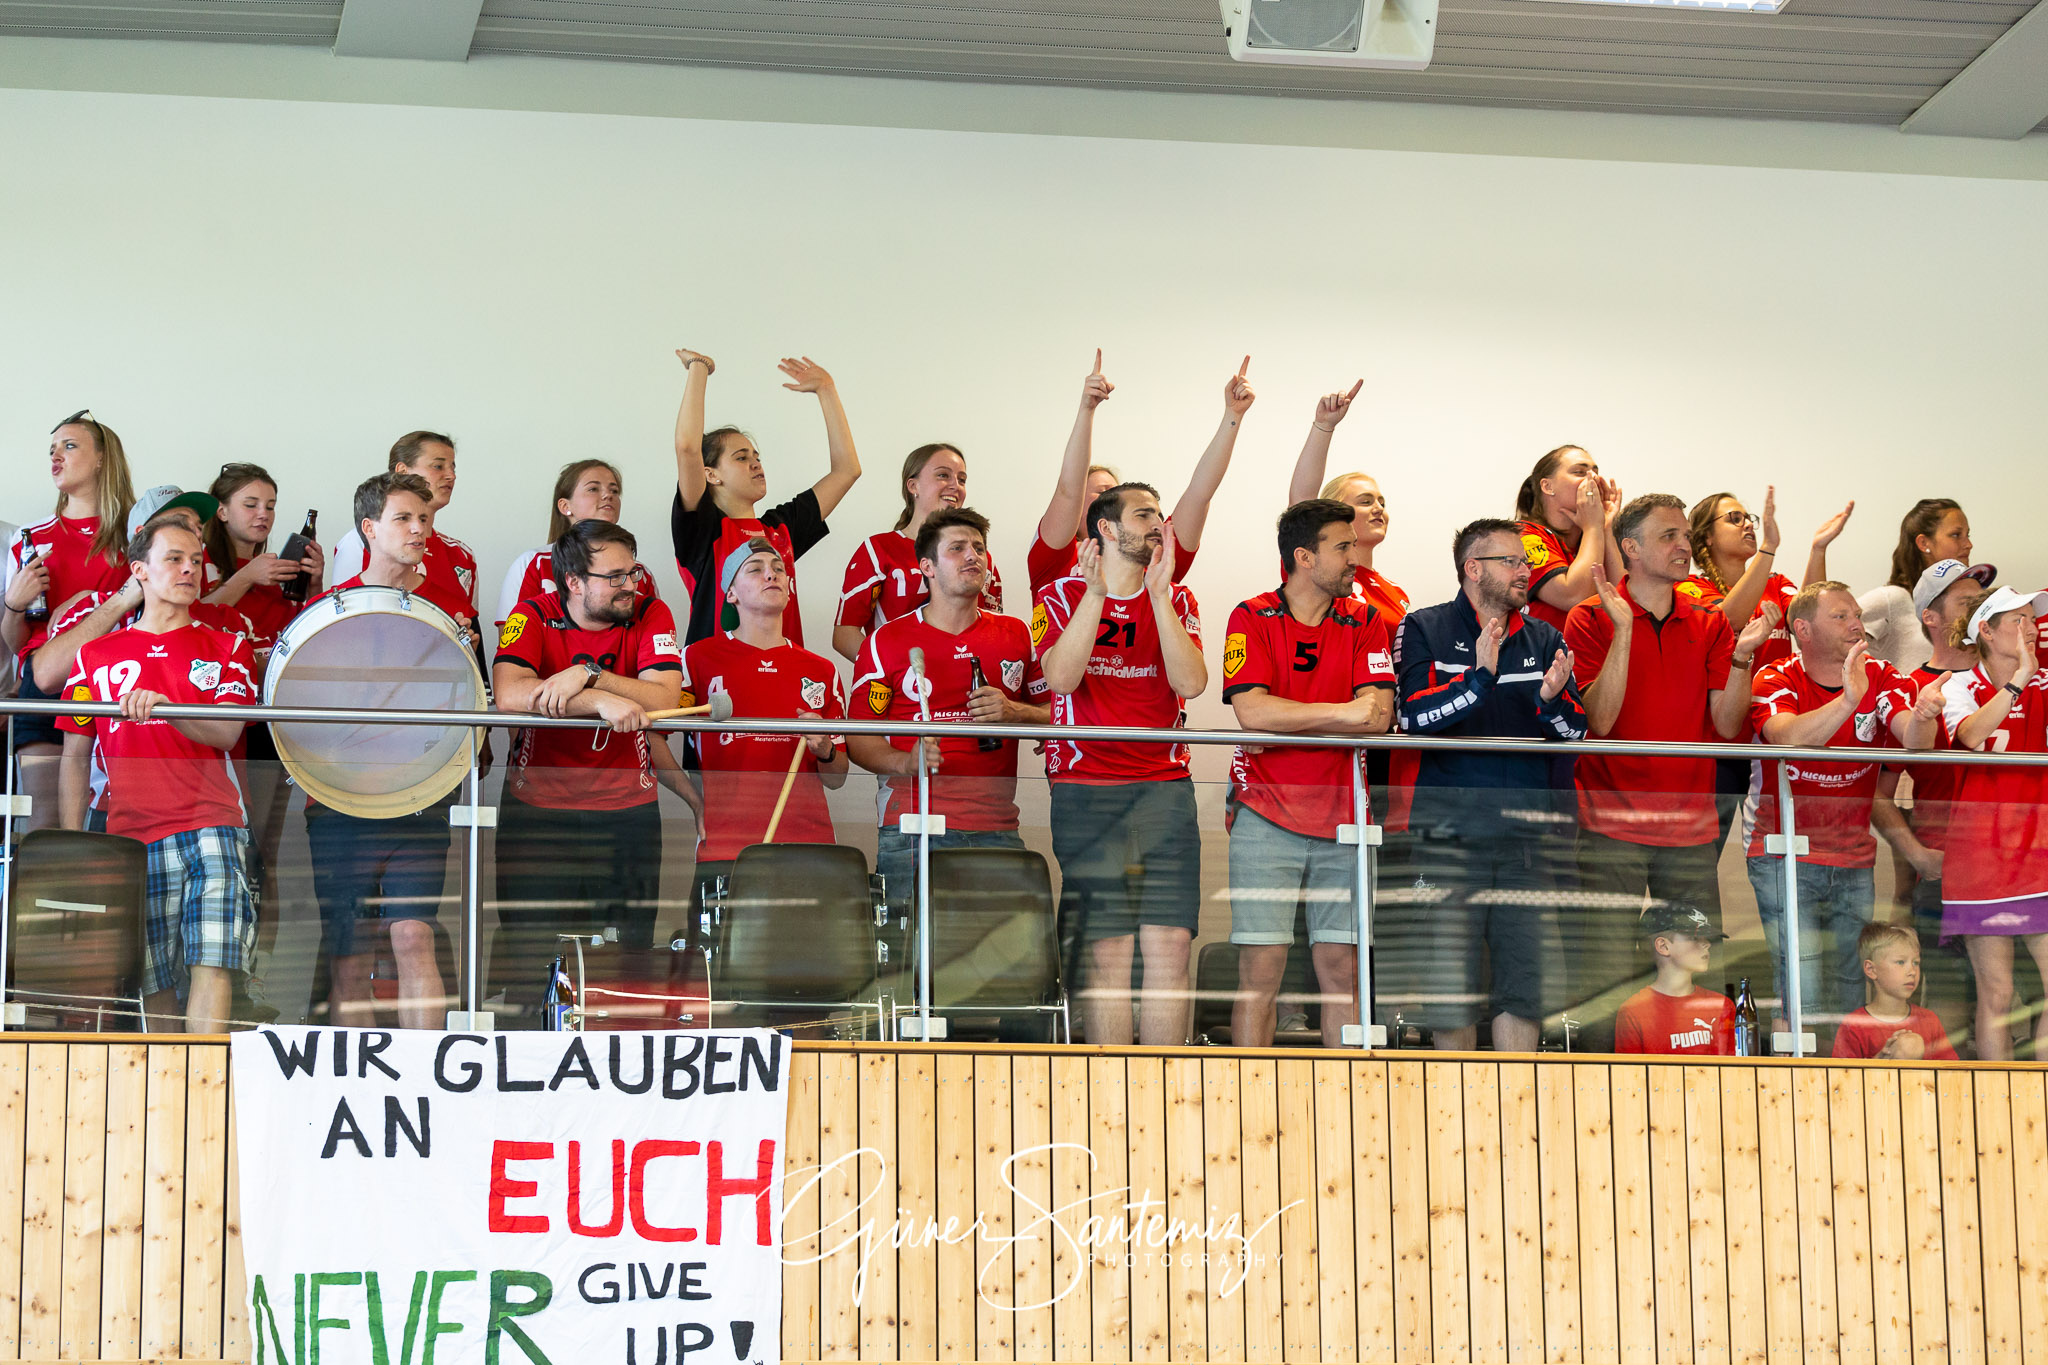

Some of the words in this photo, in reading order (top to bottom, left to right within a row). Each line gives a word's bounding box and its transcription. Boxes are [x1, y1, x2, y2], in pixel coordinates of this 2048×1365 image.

[1032, 616, 1047, 632] UK
[1109, 611, 1130, 620] erima
[1095, 618, 1137, 649] 21
[953, 651, 974, 660] erima
[1086, 662, 1158, 679] echnoMarkt
[1223, 648, 1246, 664] HUK
[1293, 641, 1318, 672] 5
[92, 659, 142, 703] 19
[902, 666, 933, 702] 6
[1801, 770, 1843, 782] MICHAEL
[1670, 1030, 1711, 1050] PUMA
[263, 1030, 401, 1081] WIR
[434, 1034, 782, 1100] GLAUBEN
[320, 1096, 431, 1159] AN
[488, 1138, 776, 1247] EUCH
[251, 1269, 553, 1365] NEVER
[577, 1262, 713, 1305] GIVE
